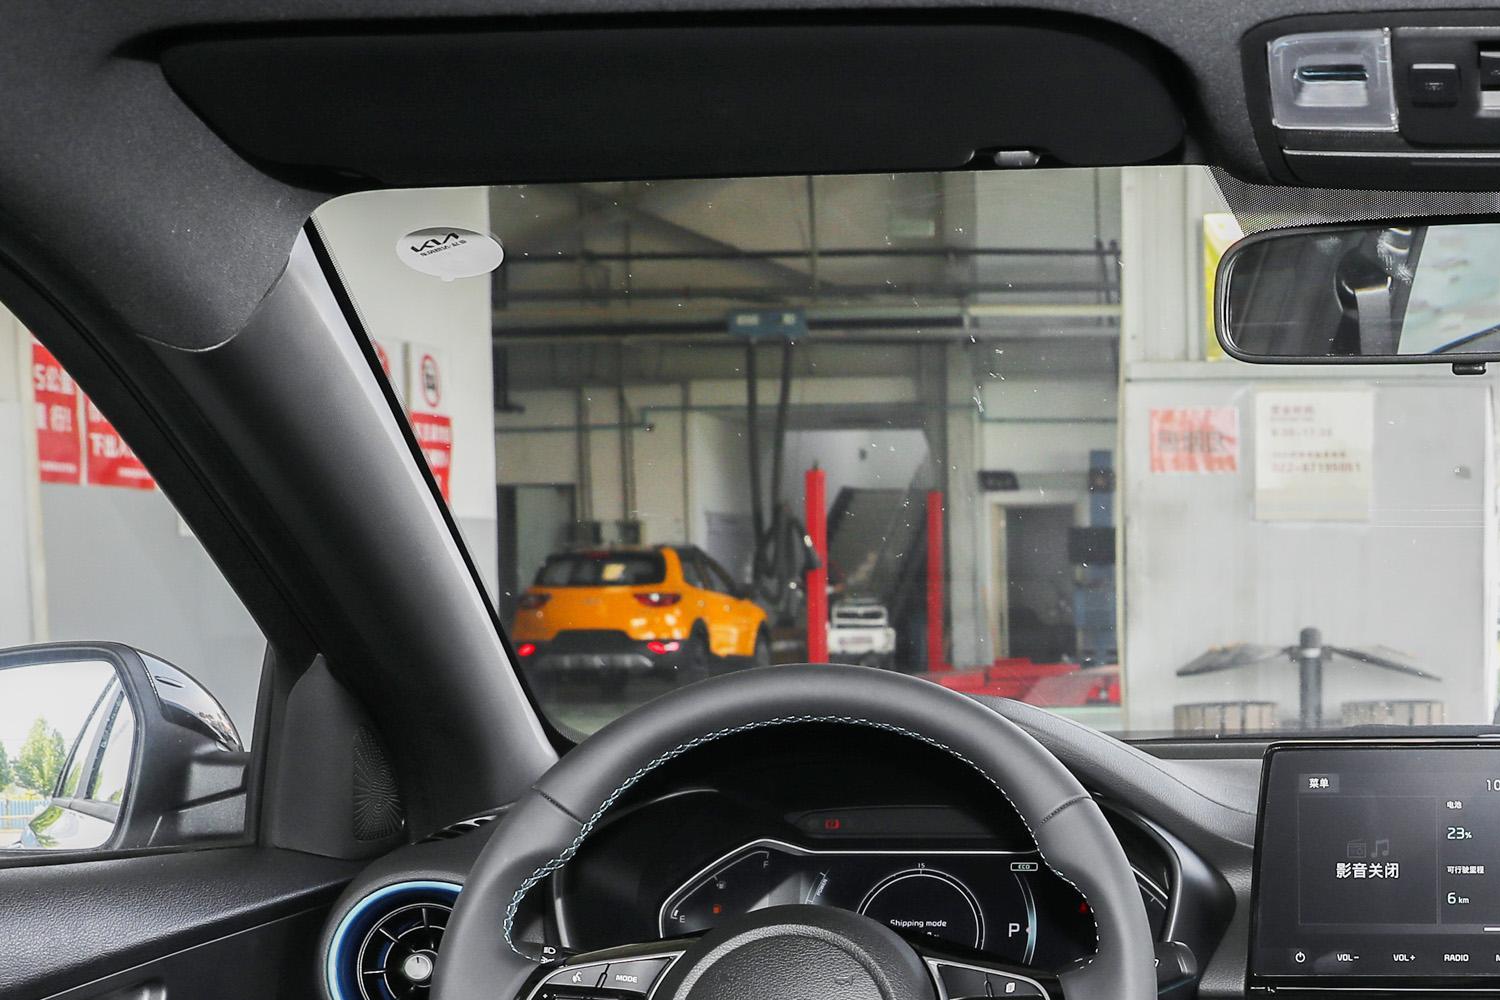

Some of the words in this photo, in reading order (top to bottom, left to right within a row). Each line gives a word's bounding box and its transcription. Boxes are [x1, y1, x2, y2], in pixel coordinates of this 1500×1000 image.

[1309, 778, 1329, 789] 菜单
[1446, 801, 1462, 809] 电池
[1447, 827, 1472, 840] 23%
[1336, 863, 1399, 879] 影音关闭
[1447, 892, 1457, 904] 6
[1458, 896, 1470, 904] km
[679, 915, 685, 923] E
[890, 919, 924, 928] Shipping
[1008, 923, 1020, 938] P
[1393, 954, 1416, 962] VOL+
[1444, 954, 1469, 962] RADIO
[615, 974, 638, 984] MODE
